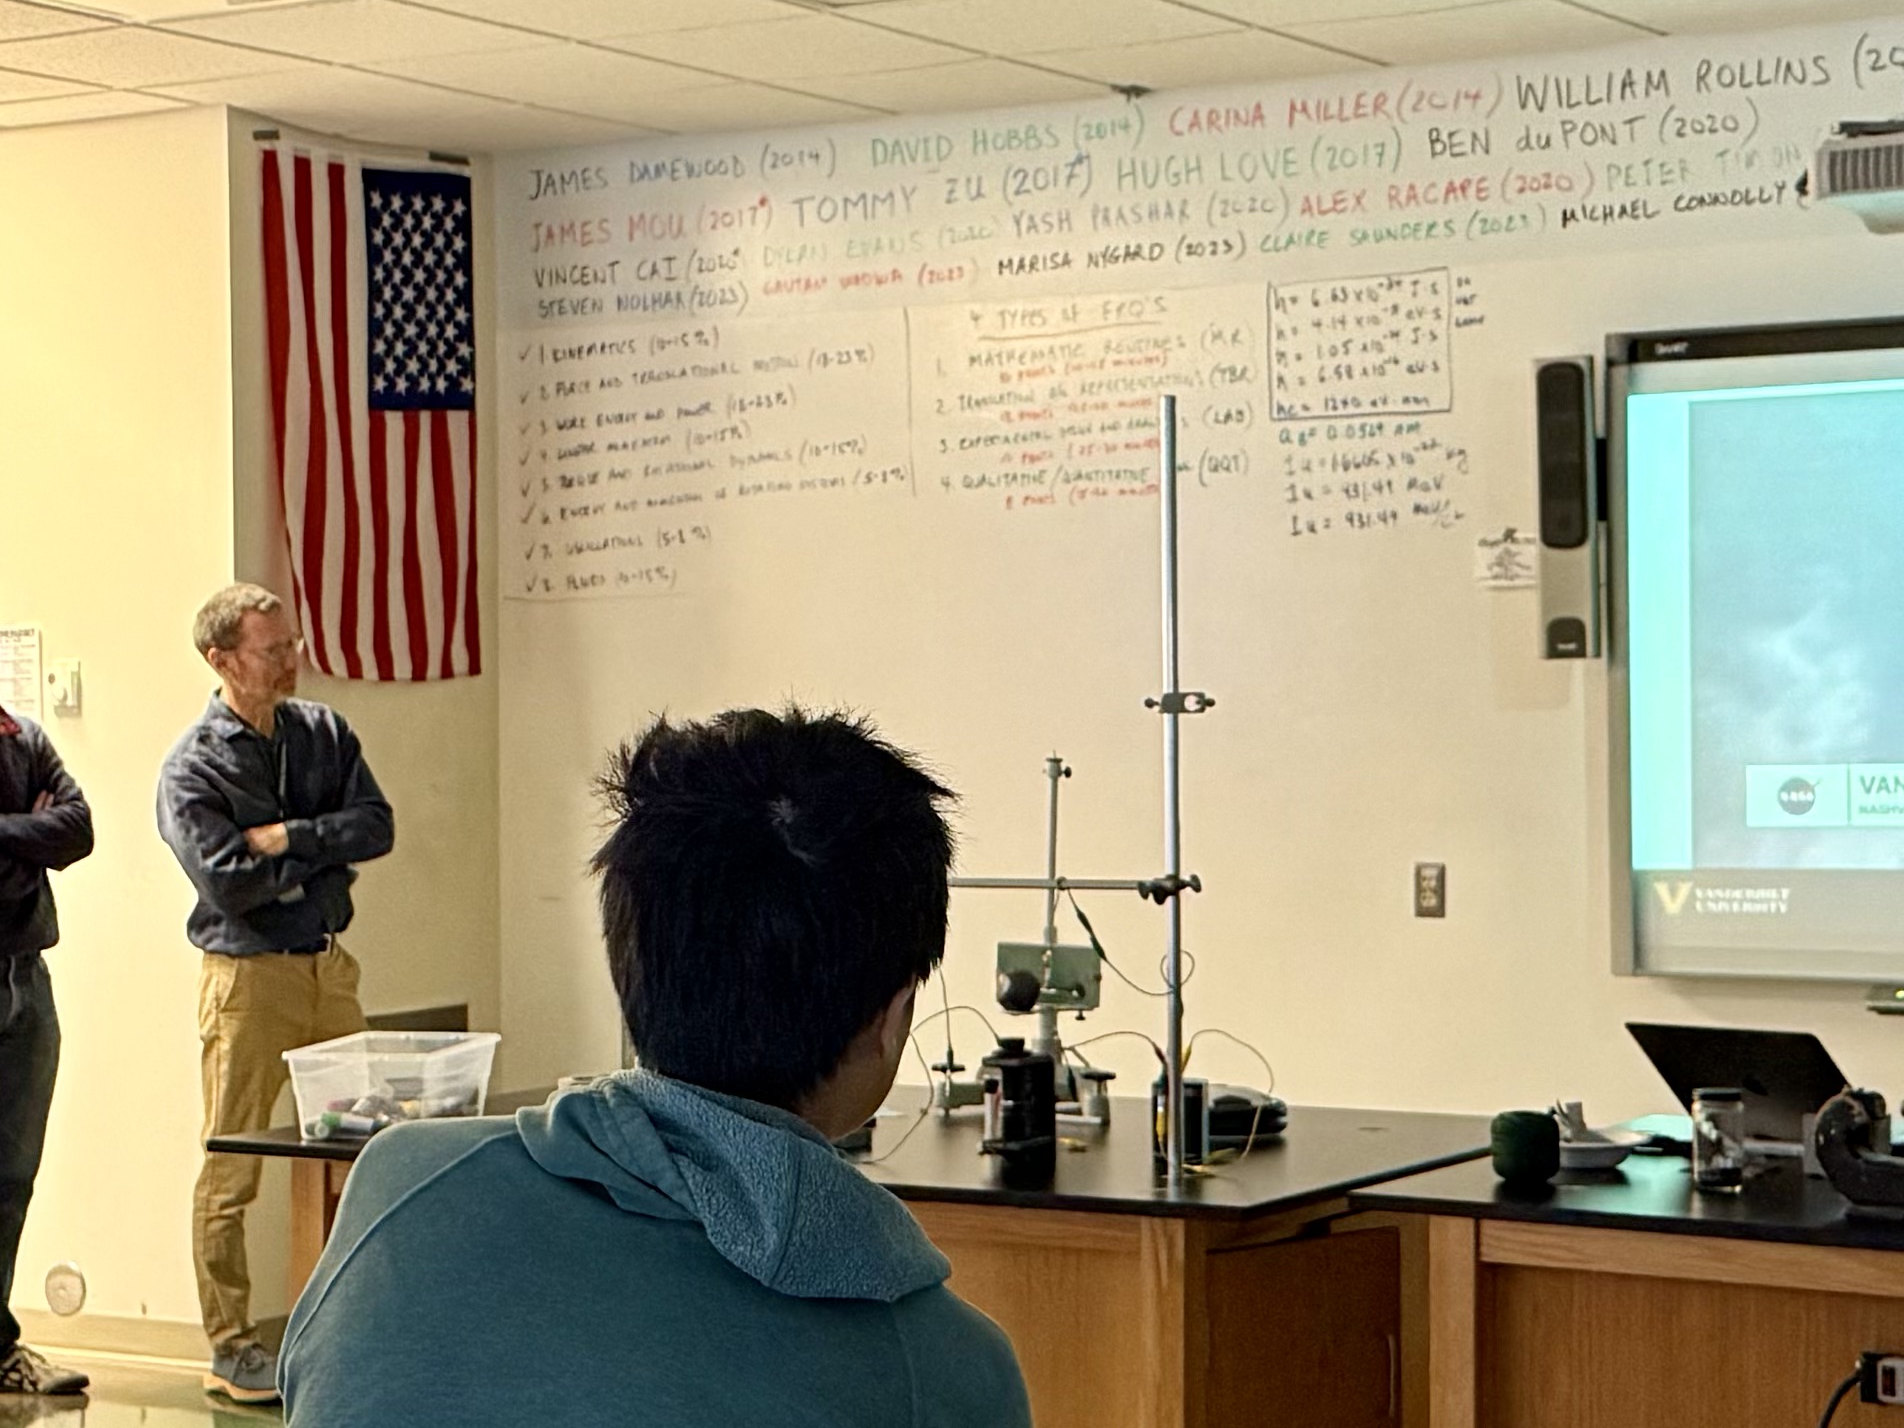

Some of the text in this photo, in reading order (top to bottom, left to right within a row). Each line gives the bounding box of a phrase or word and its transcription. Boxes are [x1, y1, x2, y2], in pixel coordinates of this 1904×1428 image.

[529, 168, 609, 200] JAMES
[871, 134, 953, 167] DAVID
[972, 124, 1059, 154] HOBBS
[1170, 101, 1265, 136] CARINA
[1289, 91, 1389, 128] MILLER
[1516, 69, 1671, 113] WILLIAM
[1696, 55, 1831, 93] ROLLINS
[531, 220, 612, 252] JAMES
[792, 185, 917, 227] TOMMY
[1117, 154, 1203, 191] HUGH
[1220, 147, 1296, 183] LOVE
[1429, 127, 1490, 158] BEN
[1659, 95, 1759, 148] (2020)
[533, 260, 620, 288] VINCENT
[637, 257, 677, 282] CAI
[1012, 209, 1072, 237] YASH
[1300, 188, 1367, 217] ALEX
[1387, 177, 1490, 211] RACAPE
[538, 297, 603, 318] STEVEN
[998, 252, 1072, 276] MARISA
[1260, 231, 1329, 253] CLAIRE
[1350, 221, 1456, 245] SAUNDERS
[1562, 198, 1660, 228] MICHAEL
